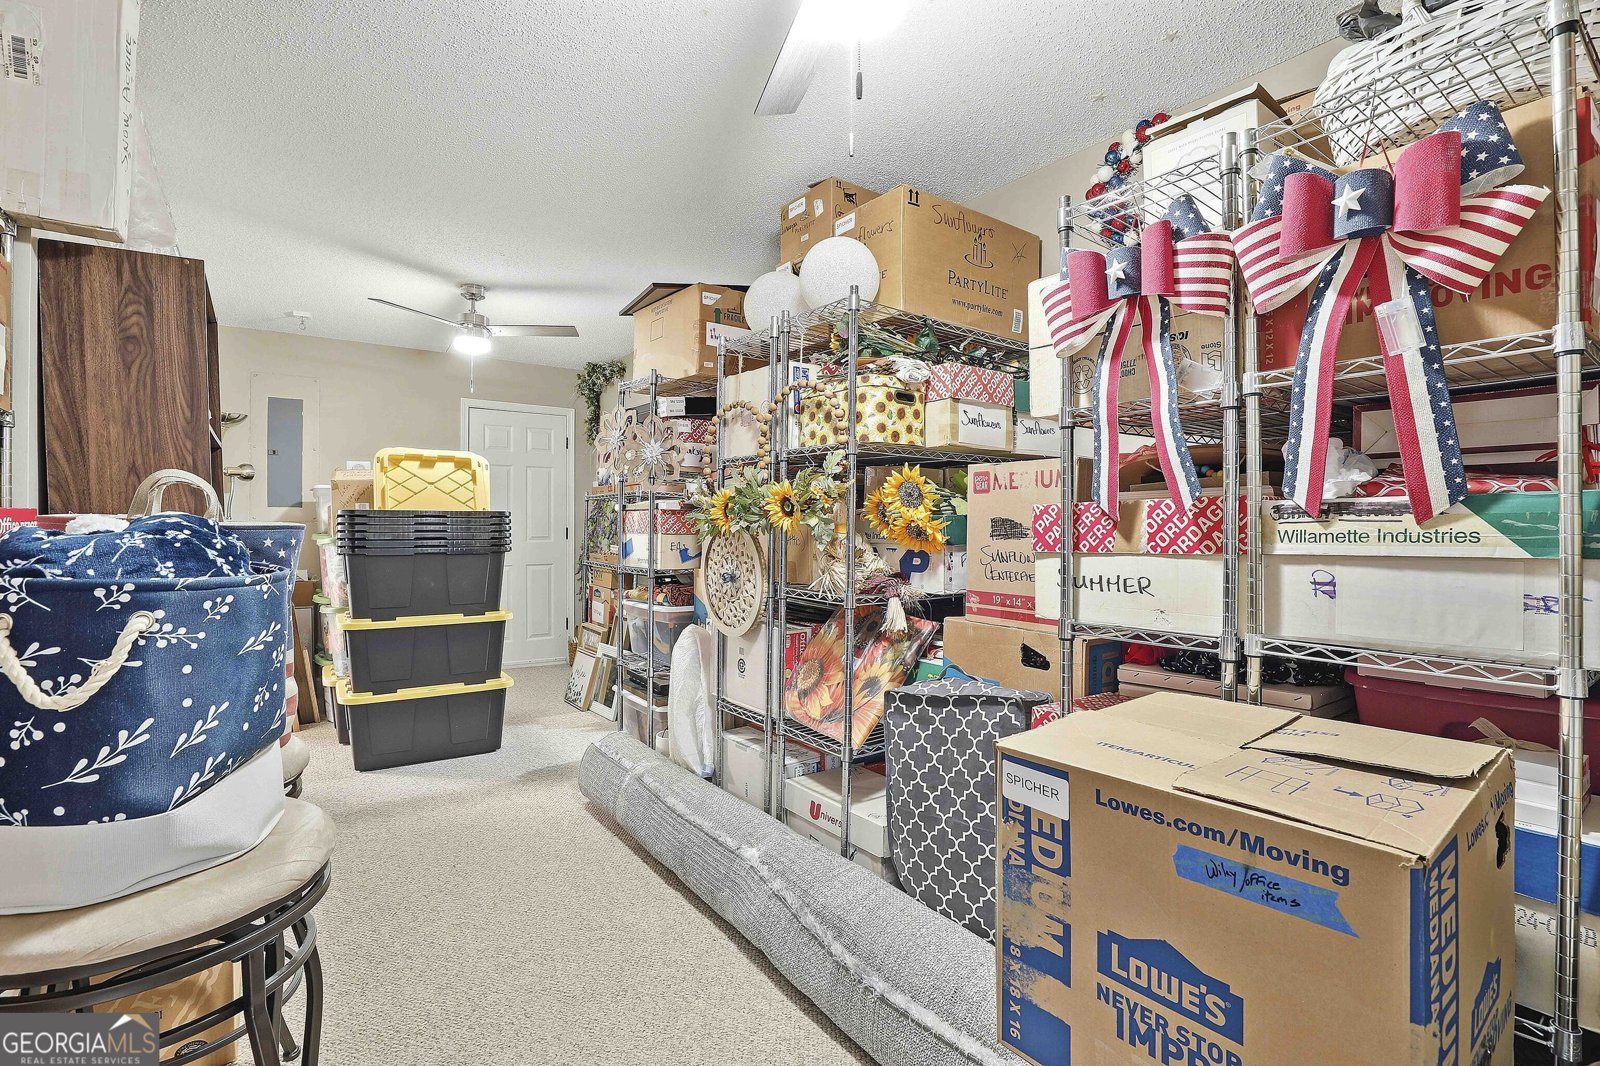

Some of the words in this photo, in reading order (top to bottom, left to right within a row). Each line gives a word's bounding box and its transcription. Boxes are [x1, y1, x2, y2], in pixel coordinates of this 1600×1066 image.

[931, 204, 995, 239] Sunflowers
[951, 298, 1004, 318] www.partylite.com
[1265, 329, 1273, 341] 12
[1265, 352, 1274, 365] 12
[961, 409, 1002, 430] Sunflowers
[1020, 419, 1056, 435] Sunflowers
[1277, 529, 1370, 544] Willamette
[1376, 528, 1481, 544] Industries
[980, 545, 1036, 566] SUNFLOW
[1056, 568, 1155, 598] UMMER
[1006, 772, 1060, 802] SPICHER
[809, 800, 843, 828] Univers
[1095, 788, 1350, 887] Lowes.com/Moving
[1031, 806, 1064, 958] EDIUM
[1261, 890, 1301, 908] items
[1111, 942, 1227, 1027] LOWE'S
[1009, 1000, 1022, 1017] X
[1096, 981, 1169, 1034] NEVER
[1009, 1018, 1022, 1040] 16
